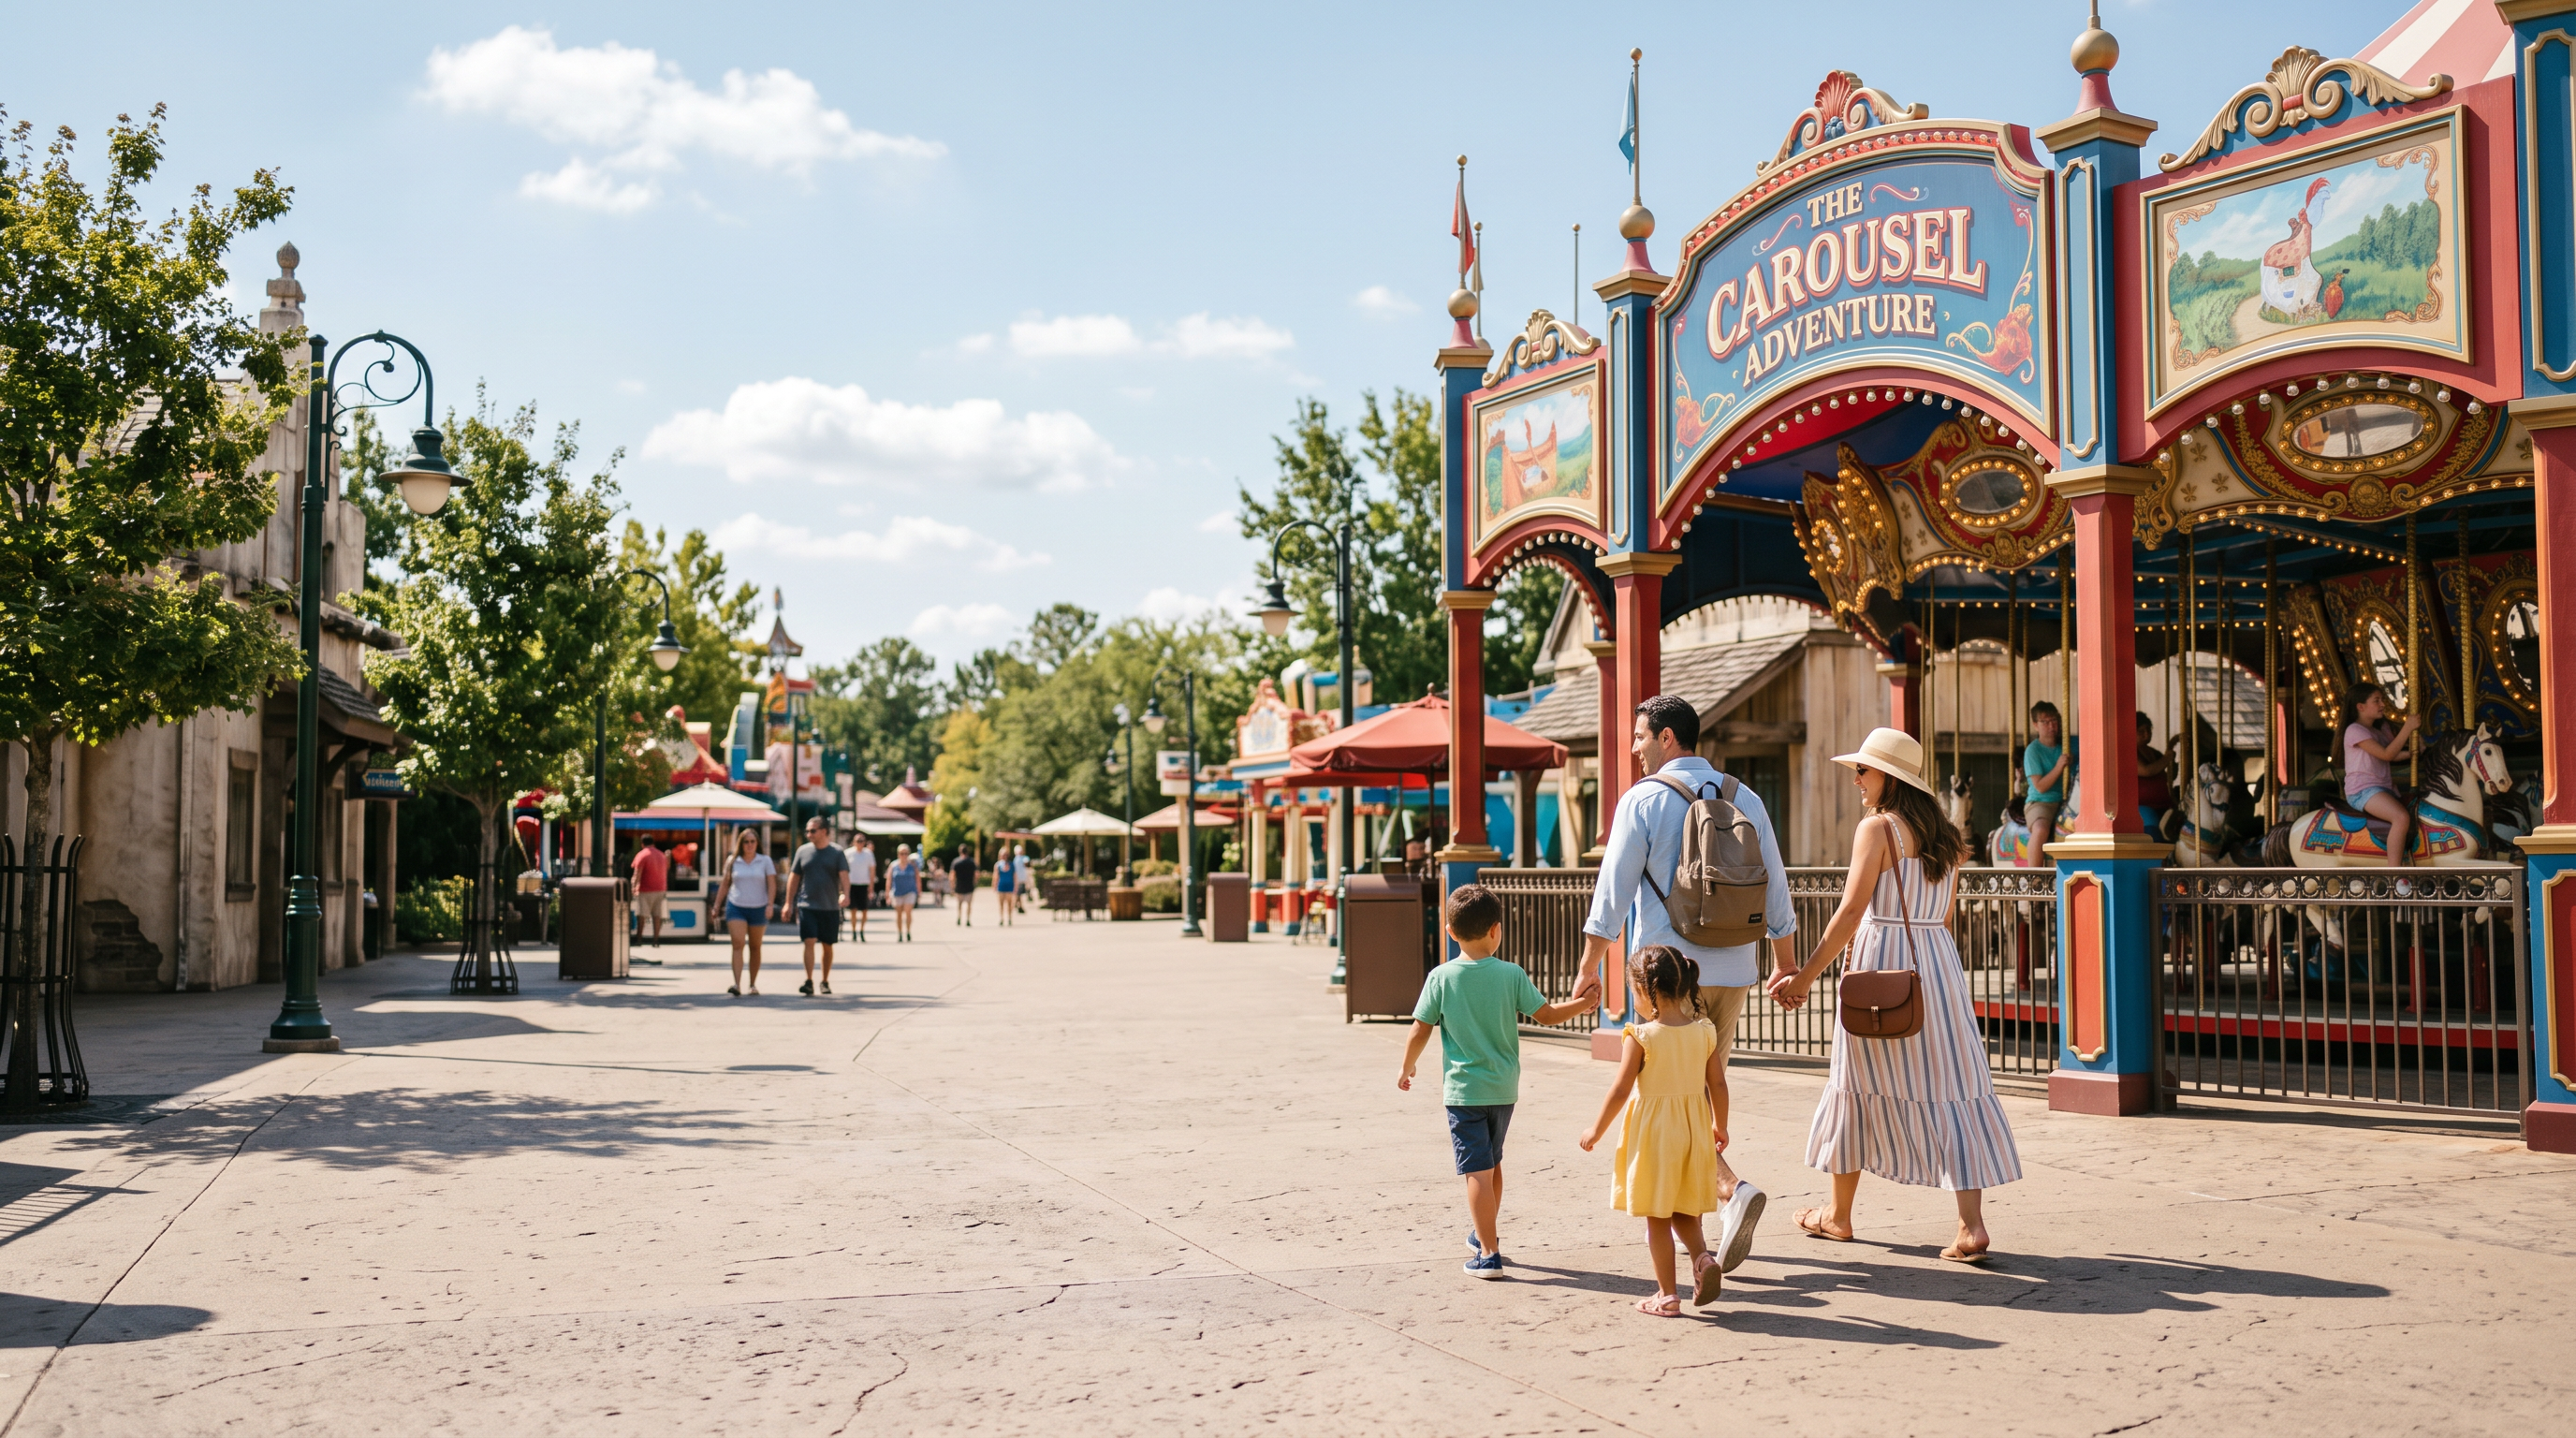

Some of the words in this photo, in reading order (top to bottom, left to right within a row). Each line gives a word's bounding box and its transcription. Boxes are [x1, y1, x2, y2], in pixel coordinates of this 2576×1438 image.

[1807, 181, 1863, 227] THE
[1706, 206, 1985, 360] CAROUSEL
[1742, 294, 1935, 388] ADVENTURE
